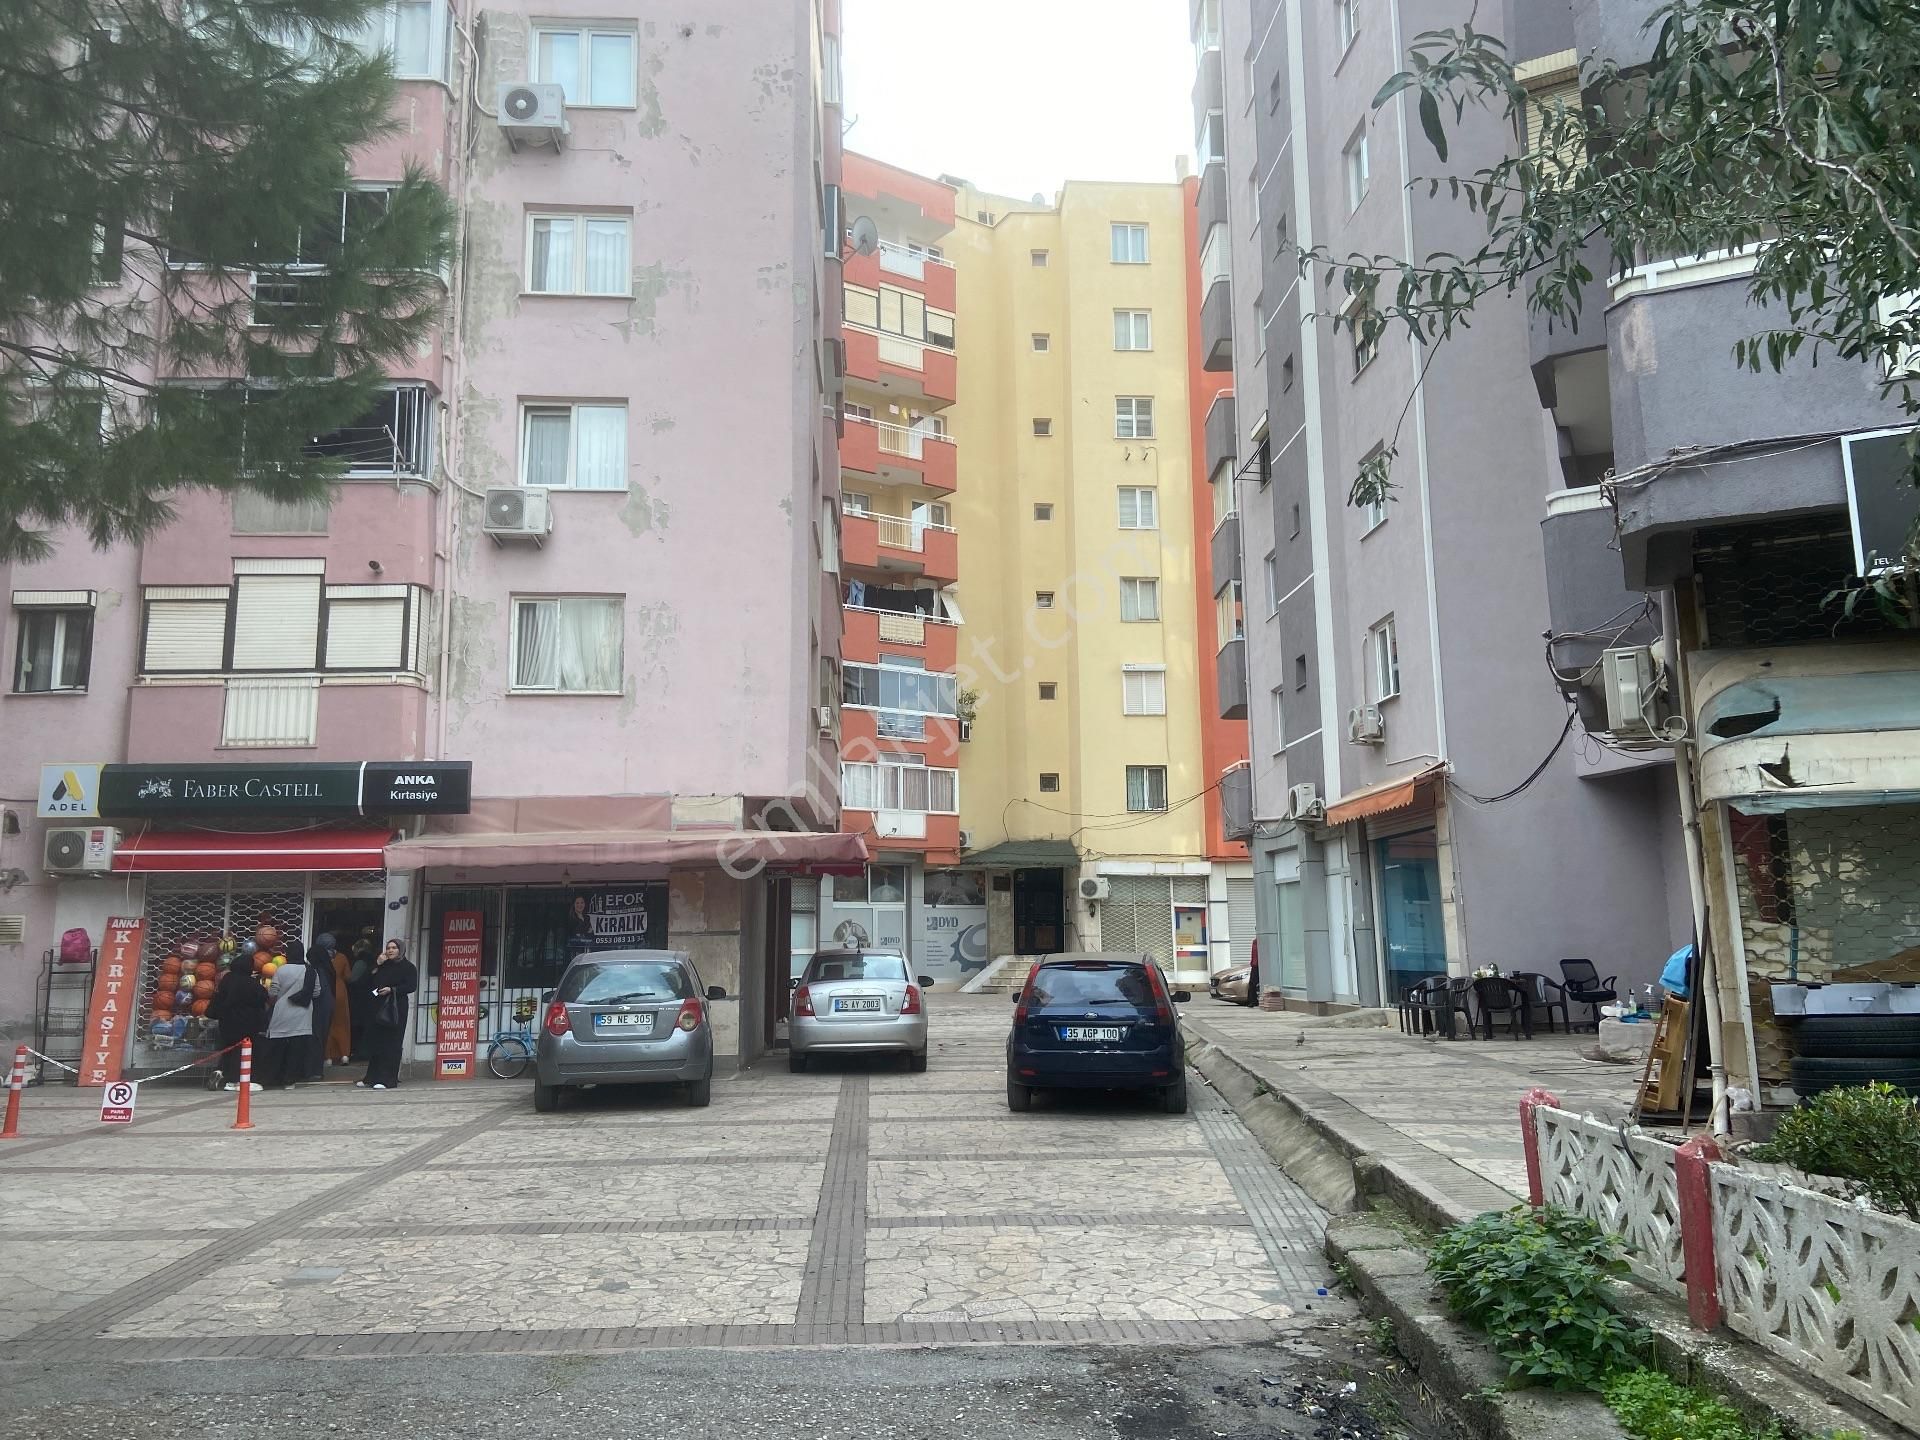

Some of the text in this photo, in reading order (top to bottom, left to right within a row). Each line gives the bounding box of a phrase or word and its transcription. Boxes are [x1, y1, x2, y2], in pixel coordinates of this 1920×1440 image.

[394, 775, 435, 785] ANKA
[390, 790, 438, 801] Kırtasiye
[48, 803, 87, 811] ADEL
[605, 892, 644, 906] EFOR
[112, 919, 140, 928] ANKA
[448, 919, 476, 932] ANKA
[451, 981, 467, 991] EŞYA
[839, 1000, 879, 1009] 35 AY 2003
[442, 1020, 475, 1029] ROMAN VE
[600, 1014, 651, 1025] 59 NE 305
[1067, 1028, 1118, 1039] 35 AGP 100
